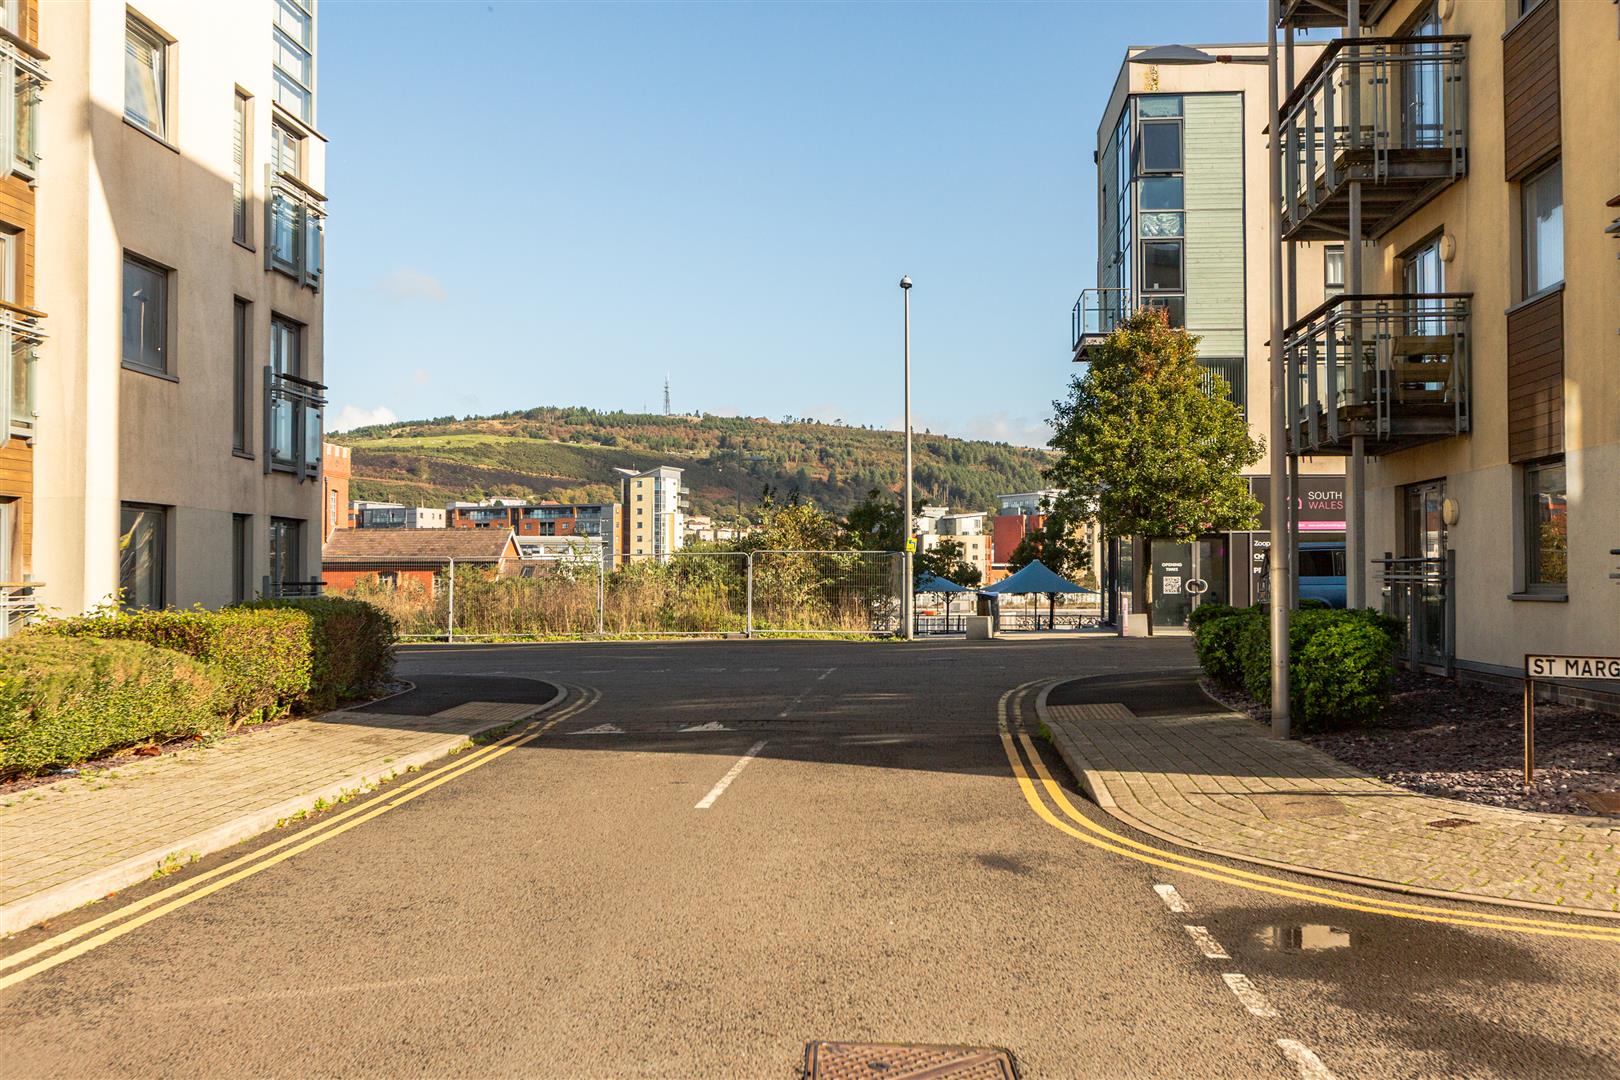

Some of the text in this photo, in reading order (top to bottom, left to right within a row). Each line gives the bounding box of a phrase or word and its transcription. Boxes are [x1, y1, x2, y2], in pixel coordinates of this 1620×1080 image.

[1308, 491, 1343, 500] SOUTH
[1308, 501, 1344, 510] WALES
[1533, 658, 1620, 677] ST MARG
